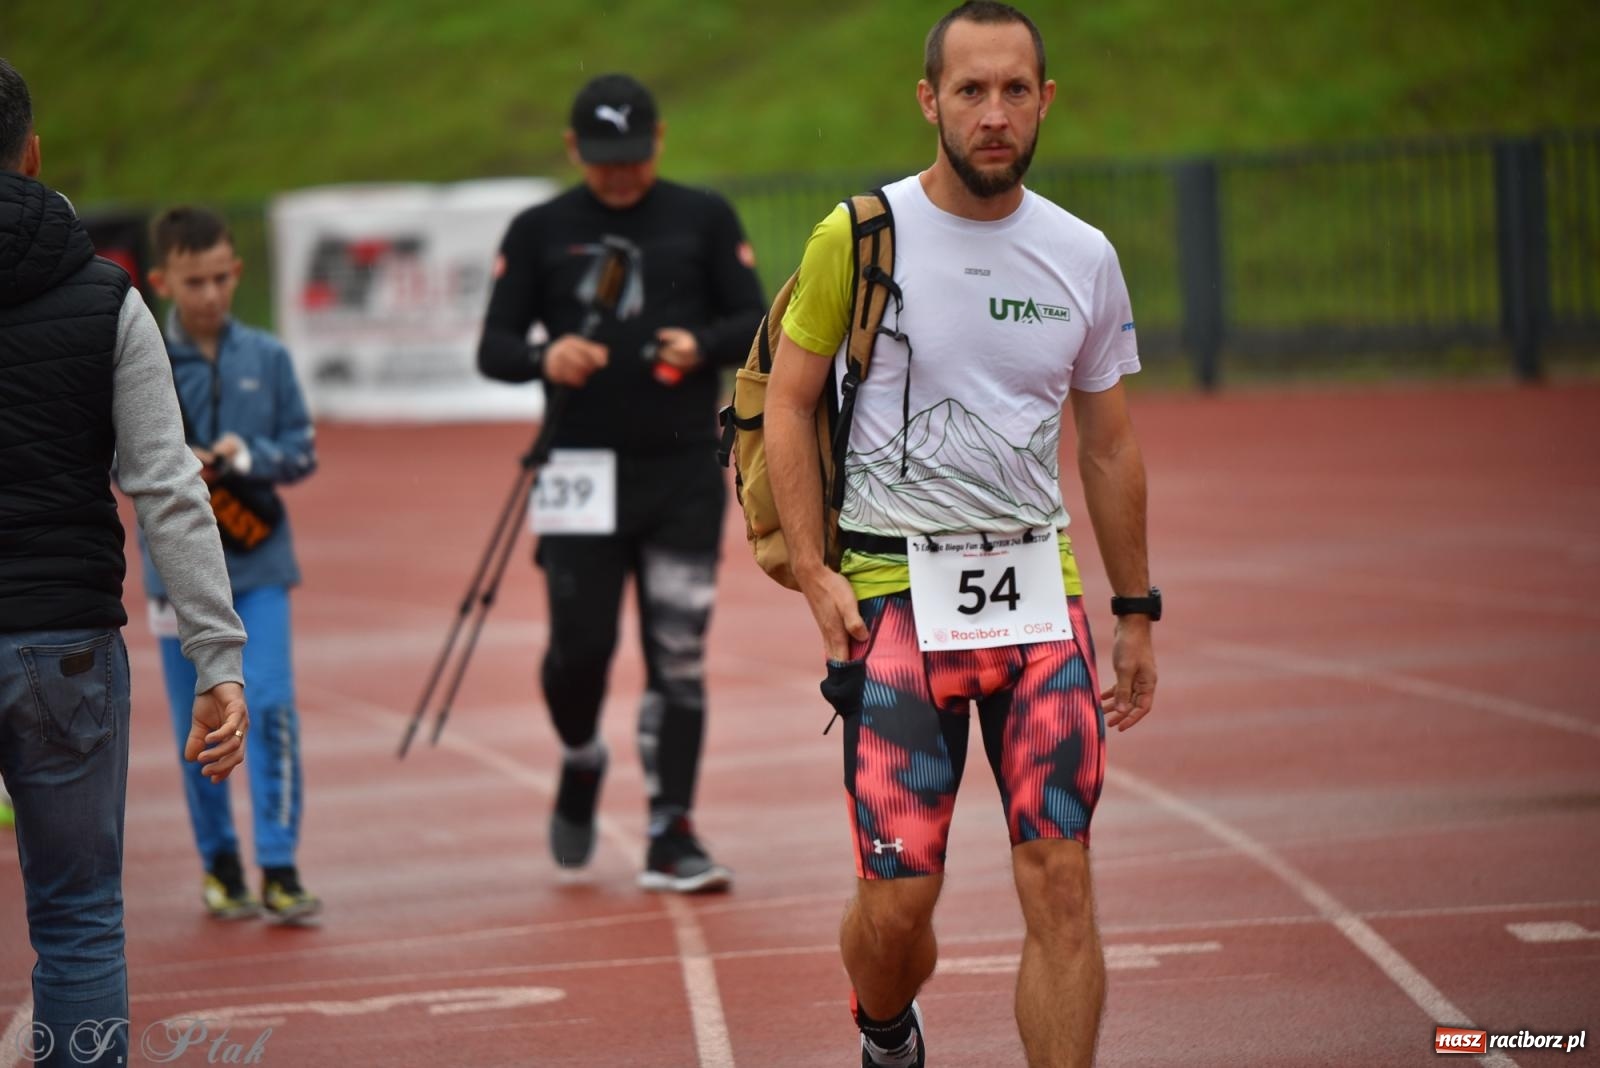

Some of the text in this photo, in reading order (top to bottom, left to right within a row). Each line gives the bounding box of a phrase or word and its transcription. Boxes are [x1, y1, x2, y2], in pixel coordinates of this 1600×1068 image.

[989, 297, 1067, 324] UTA TEAM
[957, 566, 1020, 615] 54
[951, 622, 1053, 641] Racibórz OSiR
